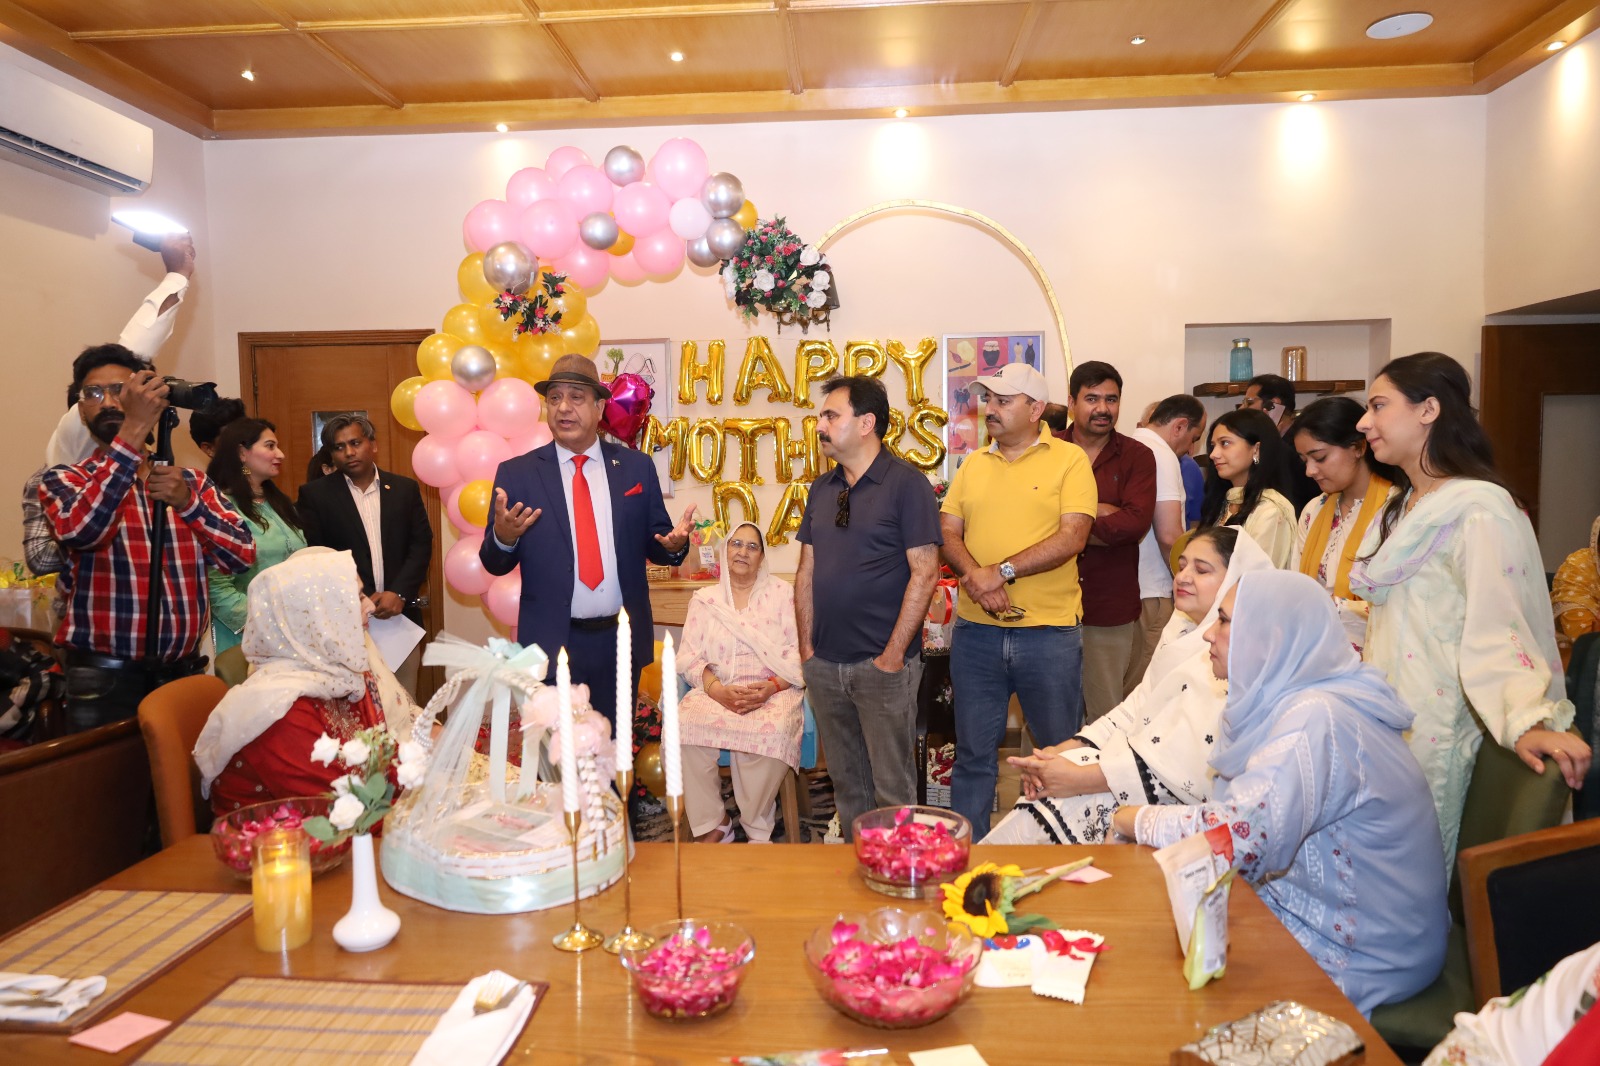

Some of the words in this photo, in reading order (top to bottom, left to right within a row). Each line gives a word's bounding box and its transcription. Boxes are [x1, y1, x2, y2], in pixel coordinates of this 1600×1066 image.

[678, 336, 937, 411] HAPPY
[641, 404, 949, 484] MOTHRS
[712, 479, 810, 547] DA
